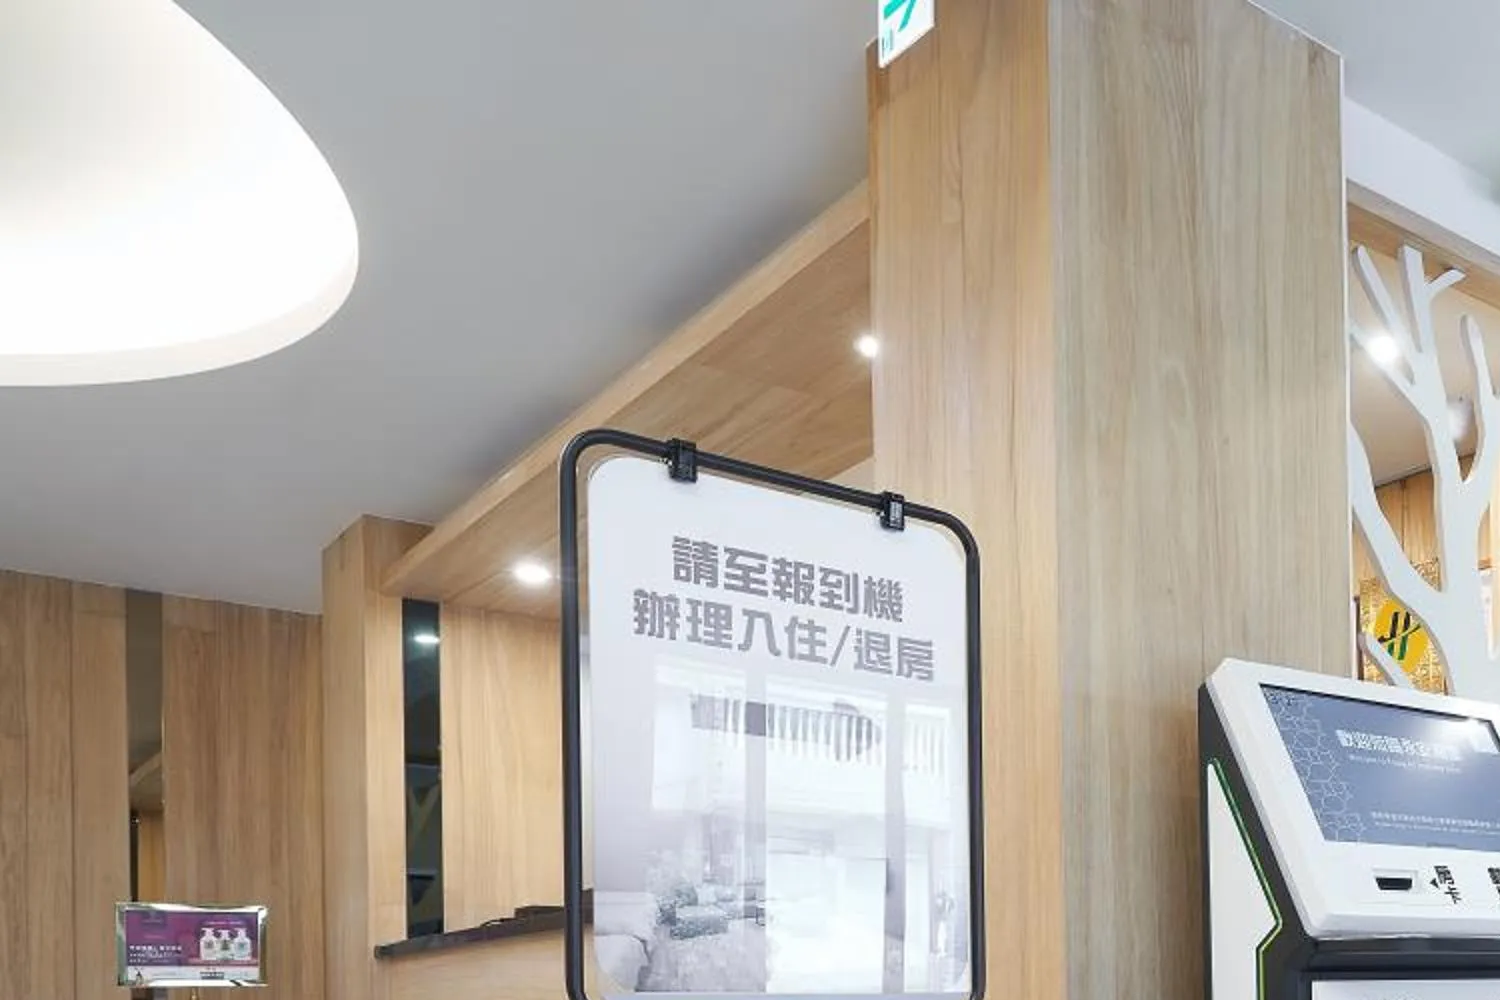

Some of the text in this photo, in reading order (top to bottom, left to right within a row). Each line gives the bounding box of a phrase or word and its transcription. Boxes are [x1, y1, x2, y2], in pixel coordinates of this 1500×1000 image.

[672, 536, 903, 622] 請至報到機
[633, 588, 934, 681] 辦理入住/退房
